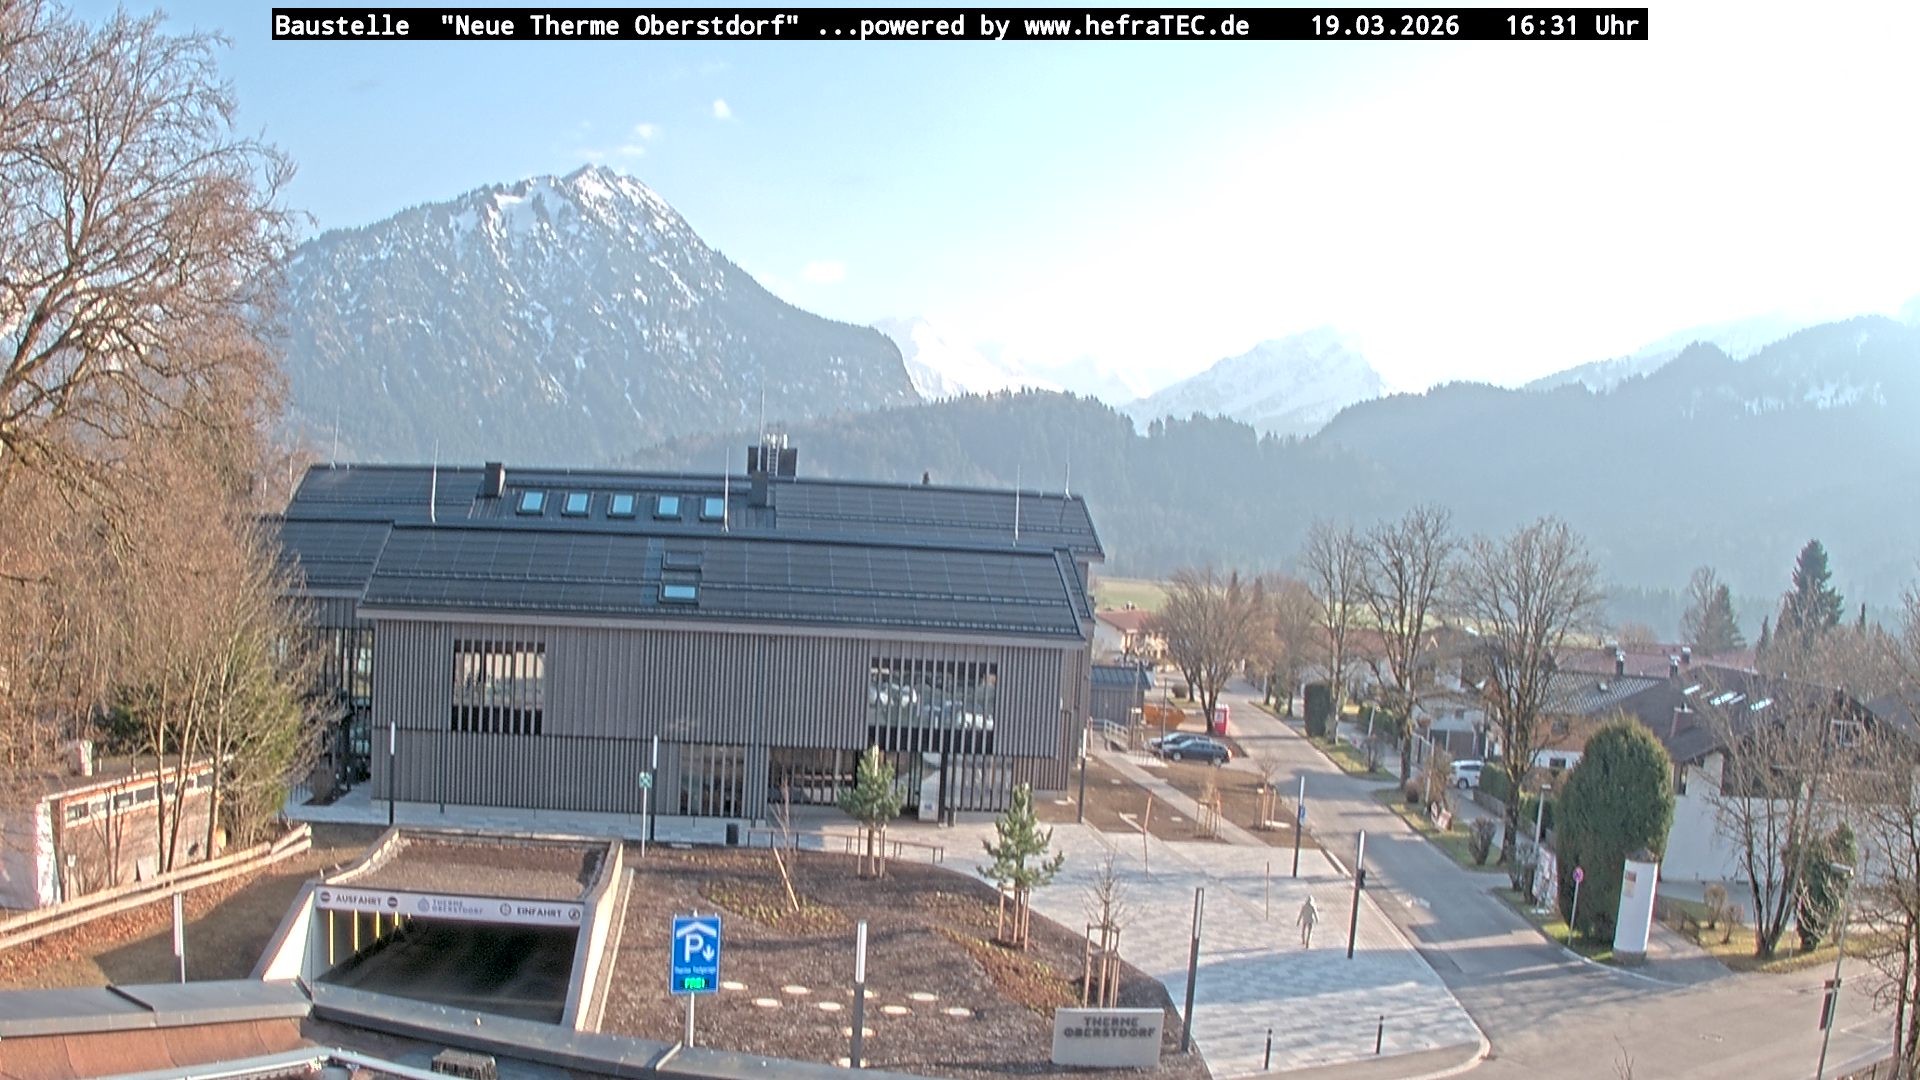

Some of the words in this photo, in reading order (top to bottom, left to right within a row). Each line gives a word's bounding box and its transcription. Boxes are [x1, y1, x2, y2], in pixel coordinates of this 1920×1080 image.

[335, 894, 382, 906] AUSFAHRT
[516, 907, 562, 919] EINFAHRT
[684, 933, 704, 963] P
[1084, 1016, 1139, 1027] THERME
[1063, 1026, 1156, 1038] OBERSTDORF
